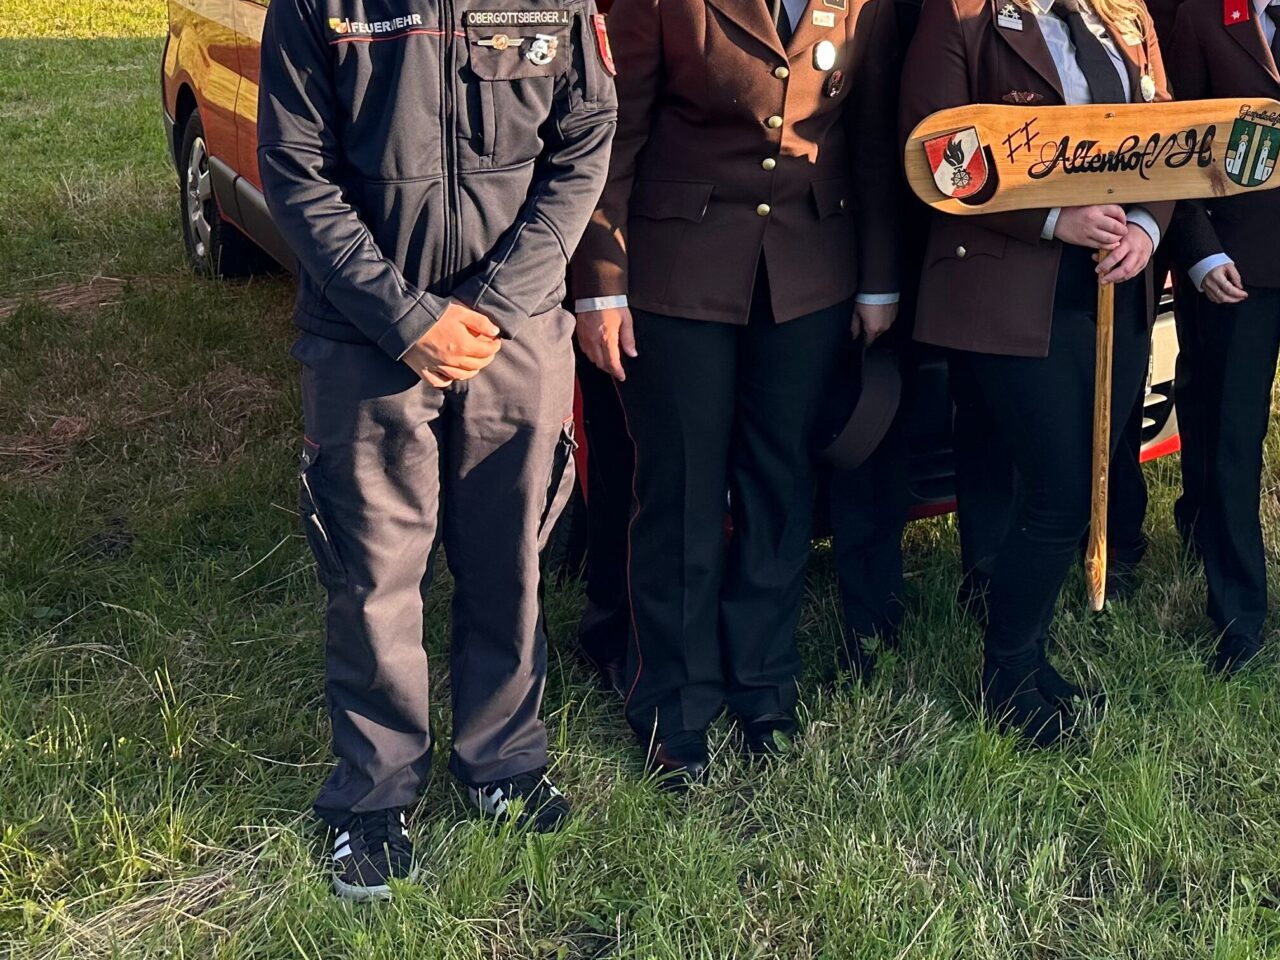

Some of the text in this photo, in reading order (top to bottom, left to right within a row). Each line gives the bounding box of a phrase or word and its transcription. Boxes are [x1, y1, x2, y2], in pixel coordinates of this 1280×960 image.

[468, 11, 569, 24] OBERGOTTSBERGER J.
[1001, 117, 1041, 165] FF
